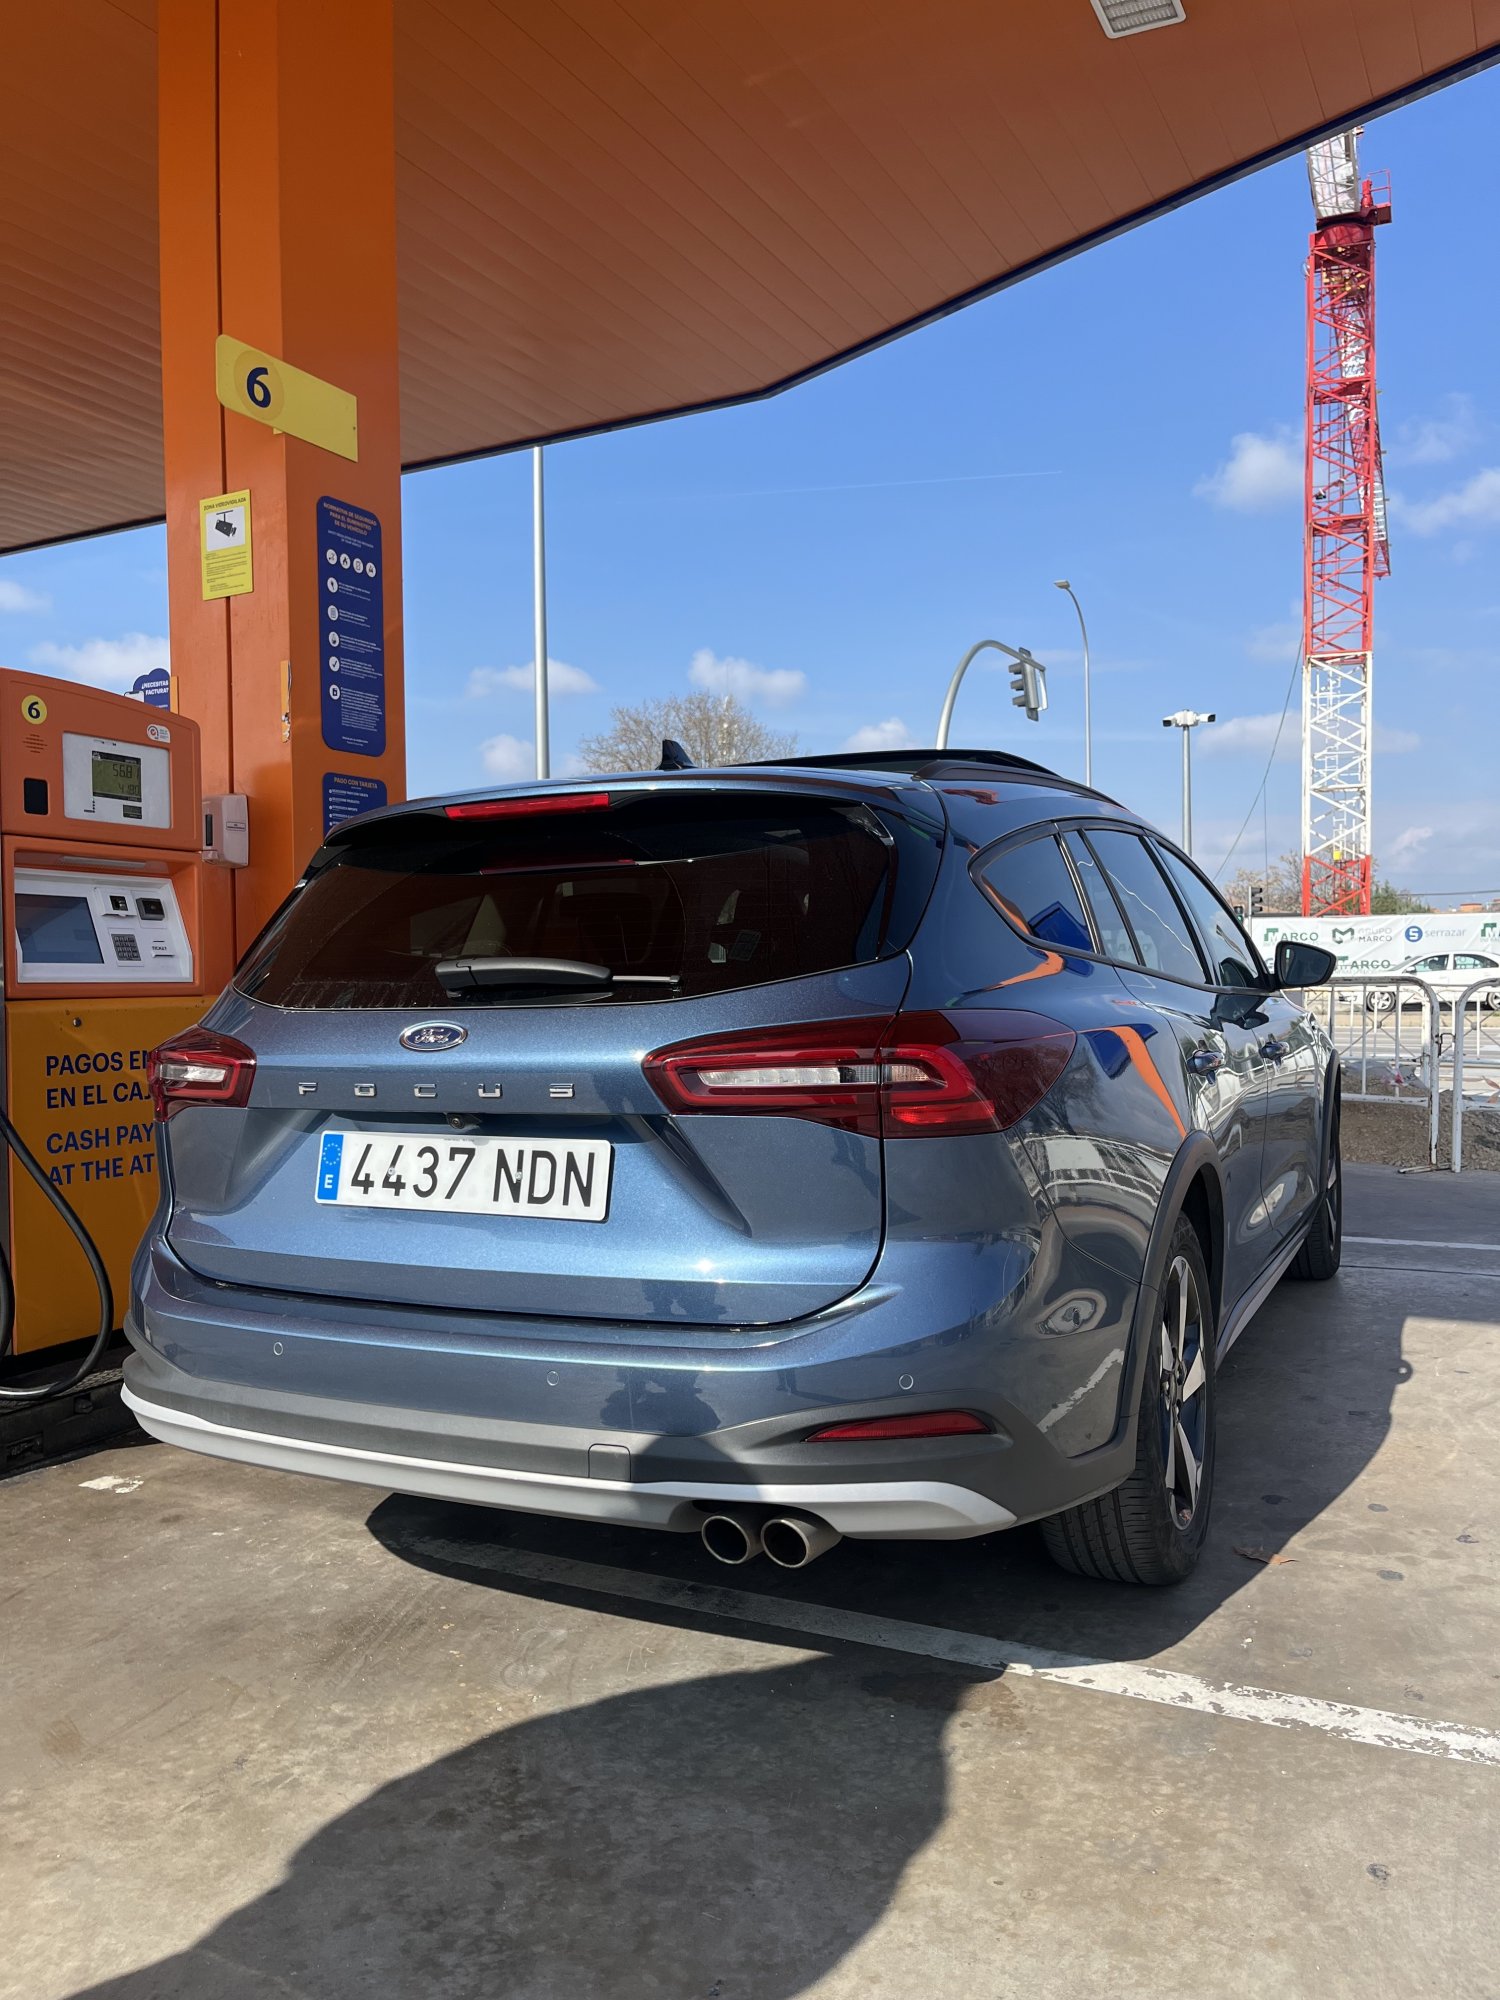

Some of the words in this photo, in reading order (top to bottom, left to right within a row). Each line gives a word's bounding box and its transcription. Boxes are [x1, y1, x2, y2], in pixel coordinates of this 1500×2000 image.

[246, 366, 271, 408] 6
[28, 701, 40, 719] 6
[1359, 935, 1393, 943] MARCO
[1425, 929, 1467, 938] serrazar
[46, 1051, 123, 1077] PAGOS
[46, 1086, 76, 1109] EN
[83, 1084, 107, 1106] EL
[298, 1082, 575, 1099] FOCUS
[46, 1127, 110, 1154] CASH
[116, 1122, 154, 1146] PAY
[50, 1163, 76, 1185] AT
[81, 1157, 124, 1182] THE
[129, 1153, 155, 1175] AT
[324, 1174, 333, 1188] E
[350, 1144, 476, 1200] 4437
[492, 1148, 595, 1207] NDN
